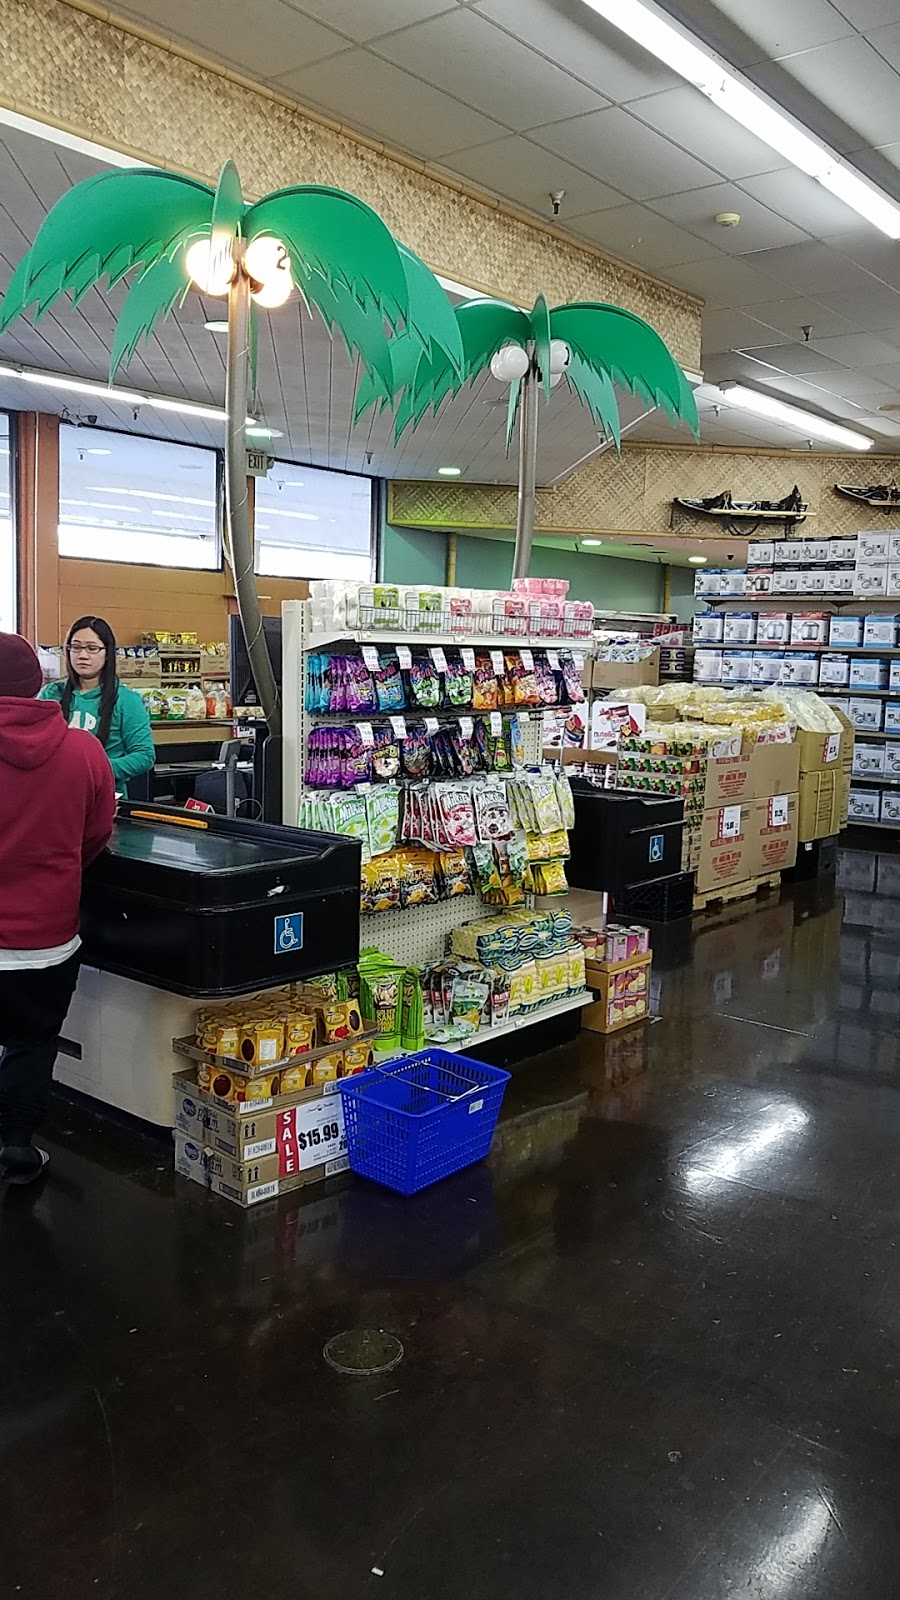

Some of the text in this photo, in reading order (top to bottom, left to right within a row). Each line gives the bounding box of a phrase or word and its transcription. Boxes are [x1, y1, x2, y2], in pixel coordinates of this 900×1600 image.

[248, 453, 264, 470] EXIT
[593, 731, 616, 739] nutella
[282, 1111, 295, 1173] SALE
[298, 1122, 339, 1151] $15.99
